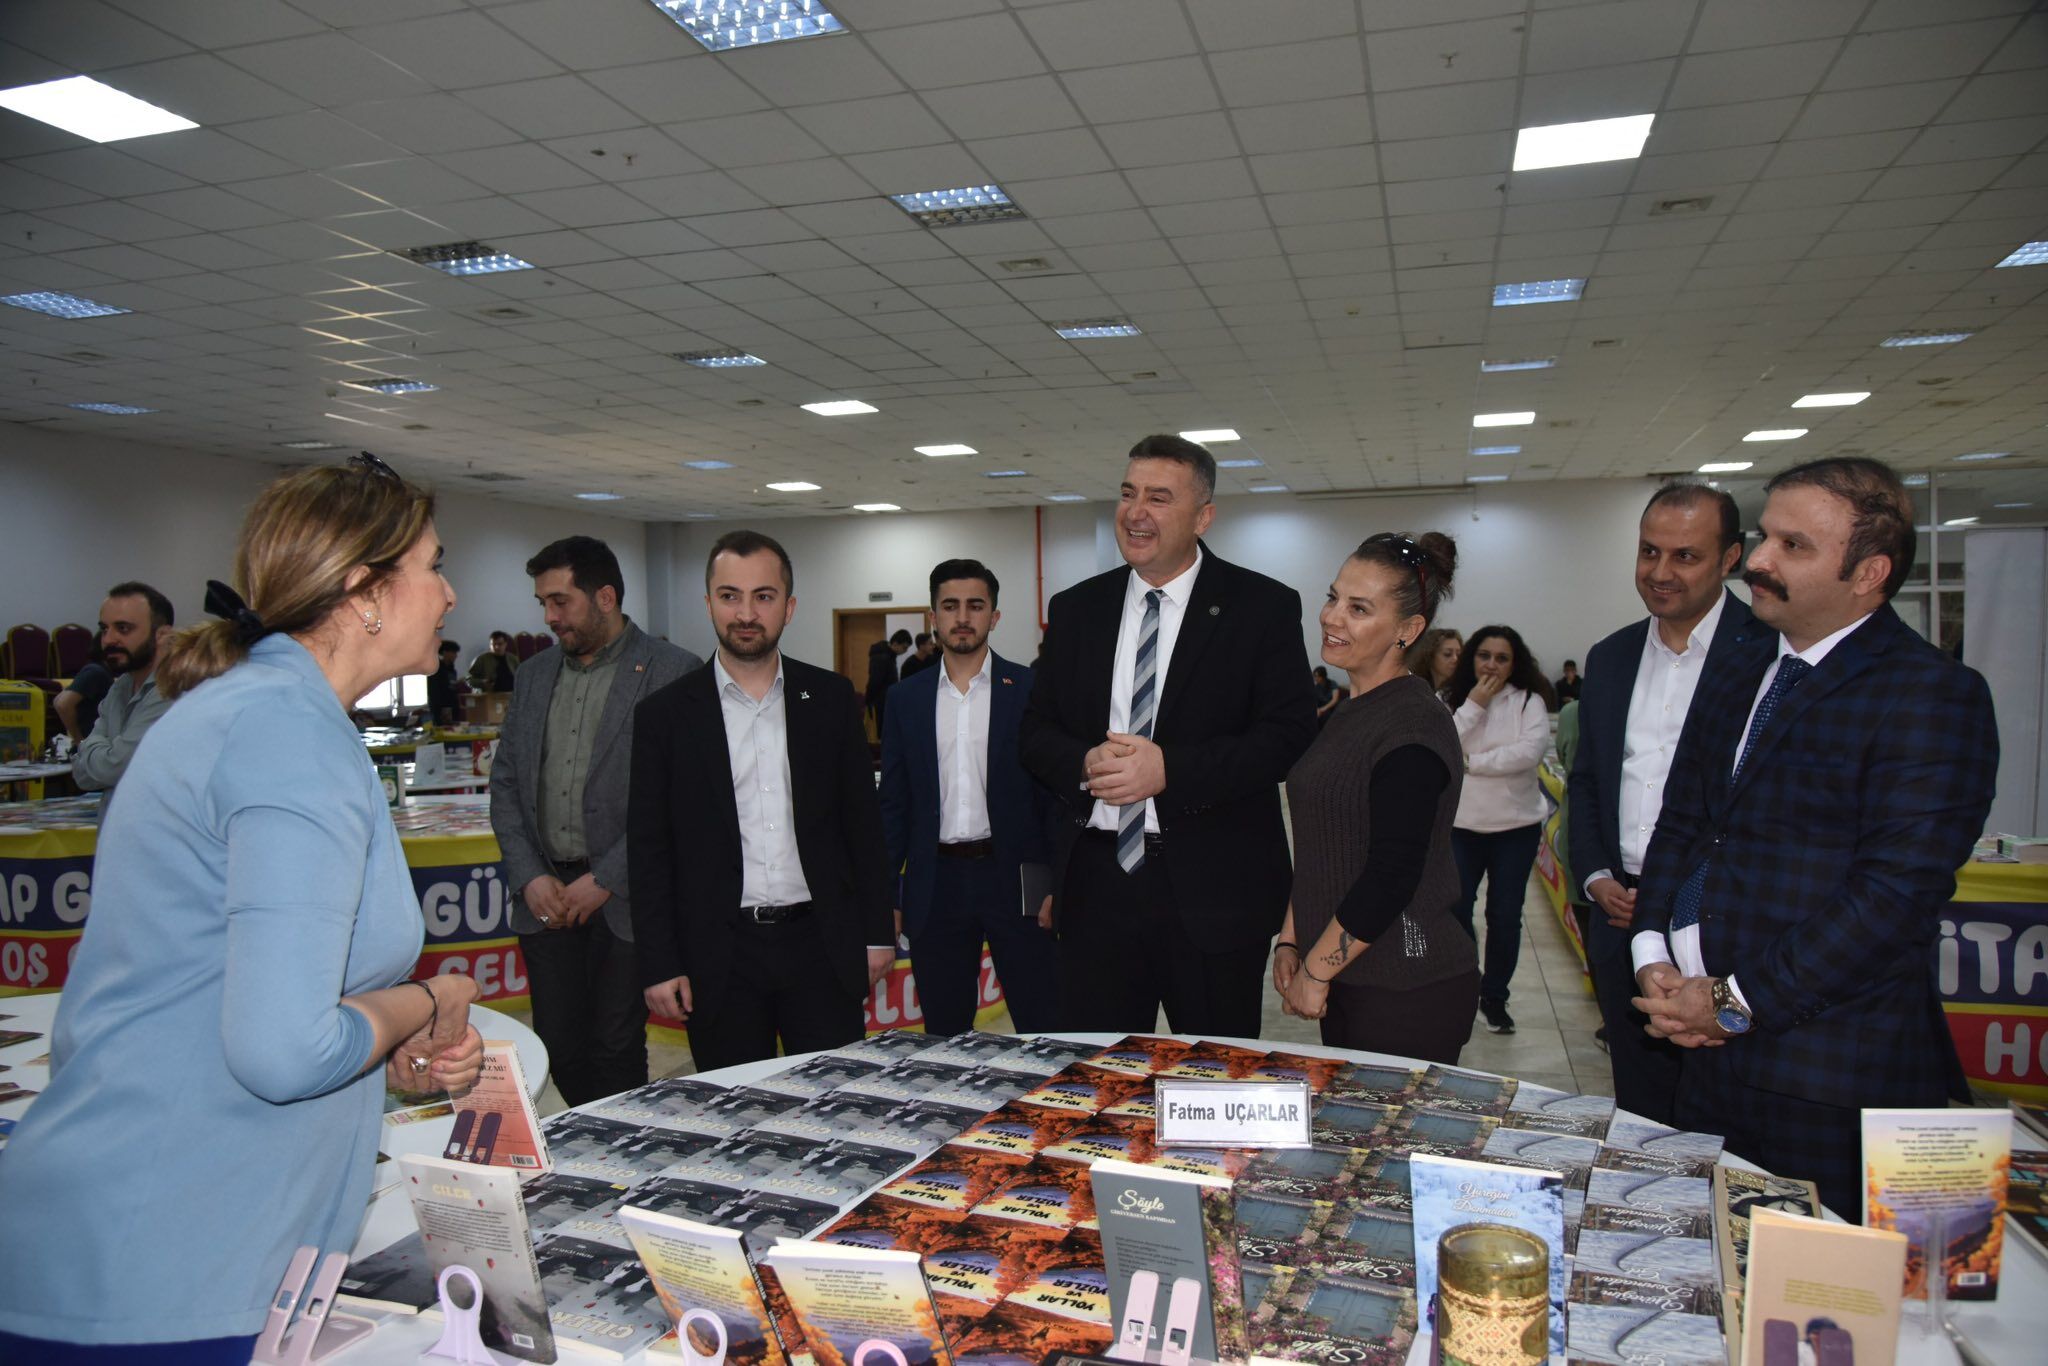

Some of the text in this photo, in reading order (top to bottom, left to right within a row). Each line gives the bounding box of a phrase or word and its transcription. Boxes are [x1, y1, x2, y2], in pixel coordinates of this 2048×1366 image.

[422, 866, 514, 937] GÜ
[1985, 1021, 2048, 1078] H
[1169, 1102, 1299, 1126] Fatma UÇARLAR
[974, 1138, 1017, 1149] YOLLAR
[1163, 1164, 1209, 1175] YOLLAR
[916, 1179, 962, 1191] YÜZLER
[900, 1189, 948, 1201] YOLLAR
[1016, 1194, 1065, 1208] YÜZLER
[1001, 1205, 1051, 1219] YOLLAR
[1052, 1278, 1108, 1296] YÜZLER
[1037, 1294, 1096, 1311] YOLLAR
